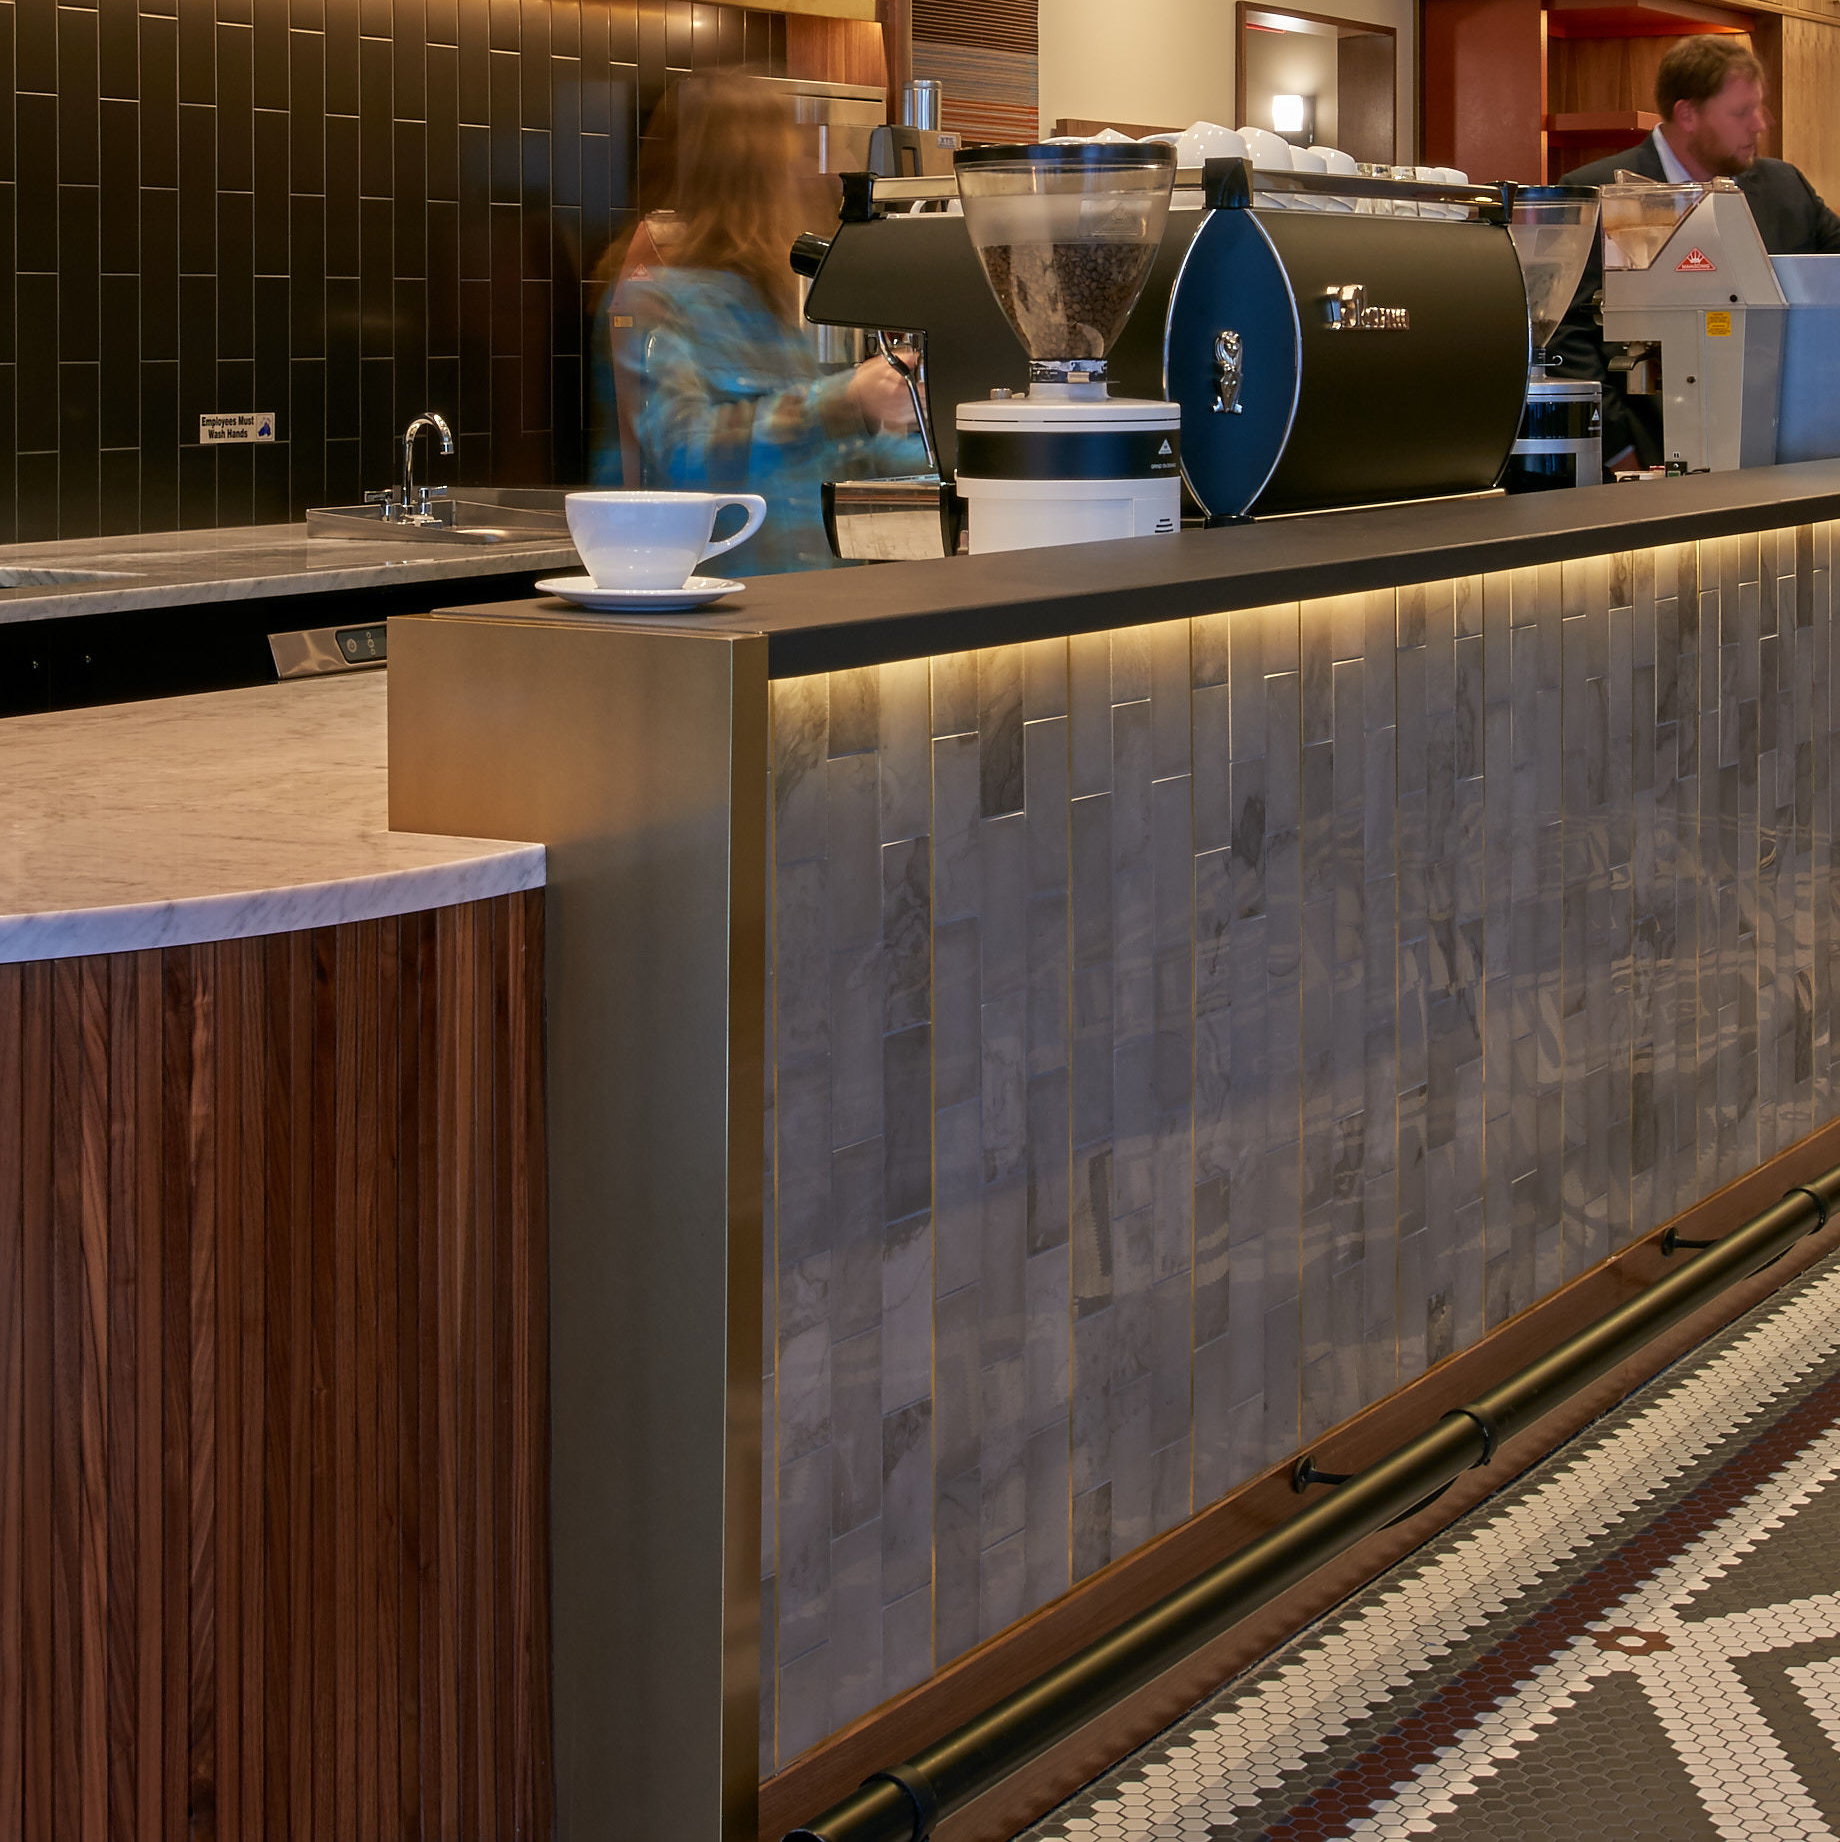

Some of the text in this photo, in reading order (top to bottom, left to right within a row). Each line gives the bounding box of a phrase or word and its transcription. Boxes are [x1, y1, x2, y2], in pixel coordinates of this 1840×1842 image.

[202, 416, 255, 428] Employees Must
[208, 429, 248, 439] Wash Hands
